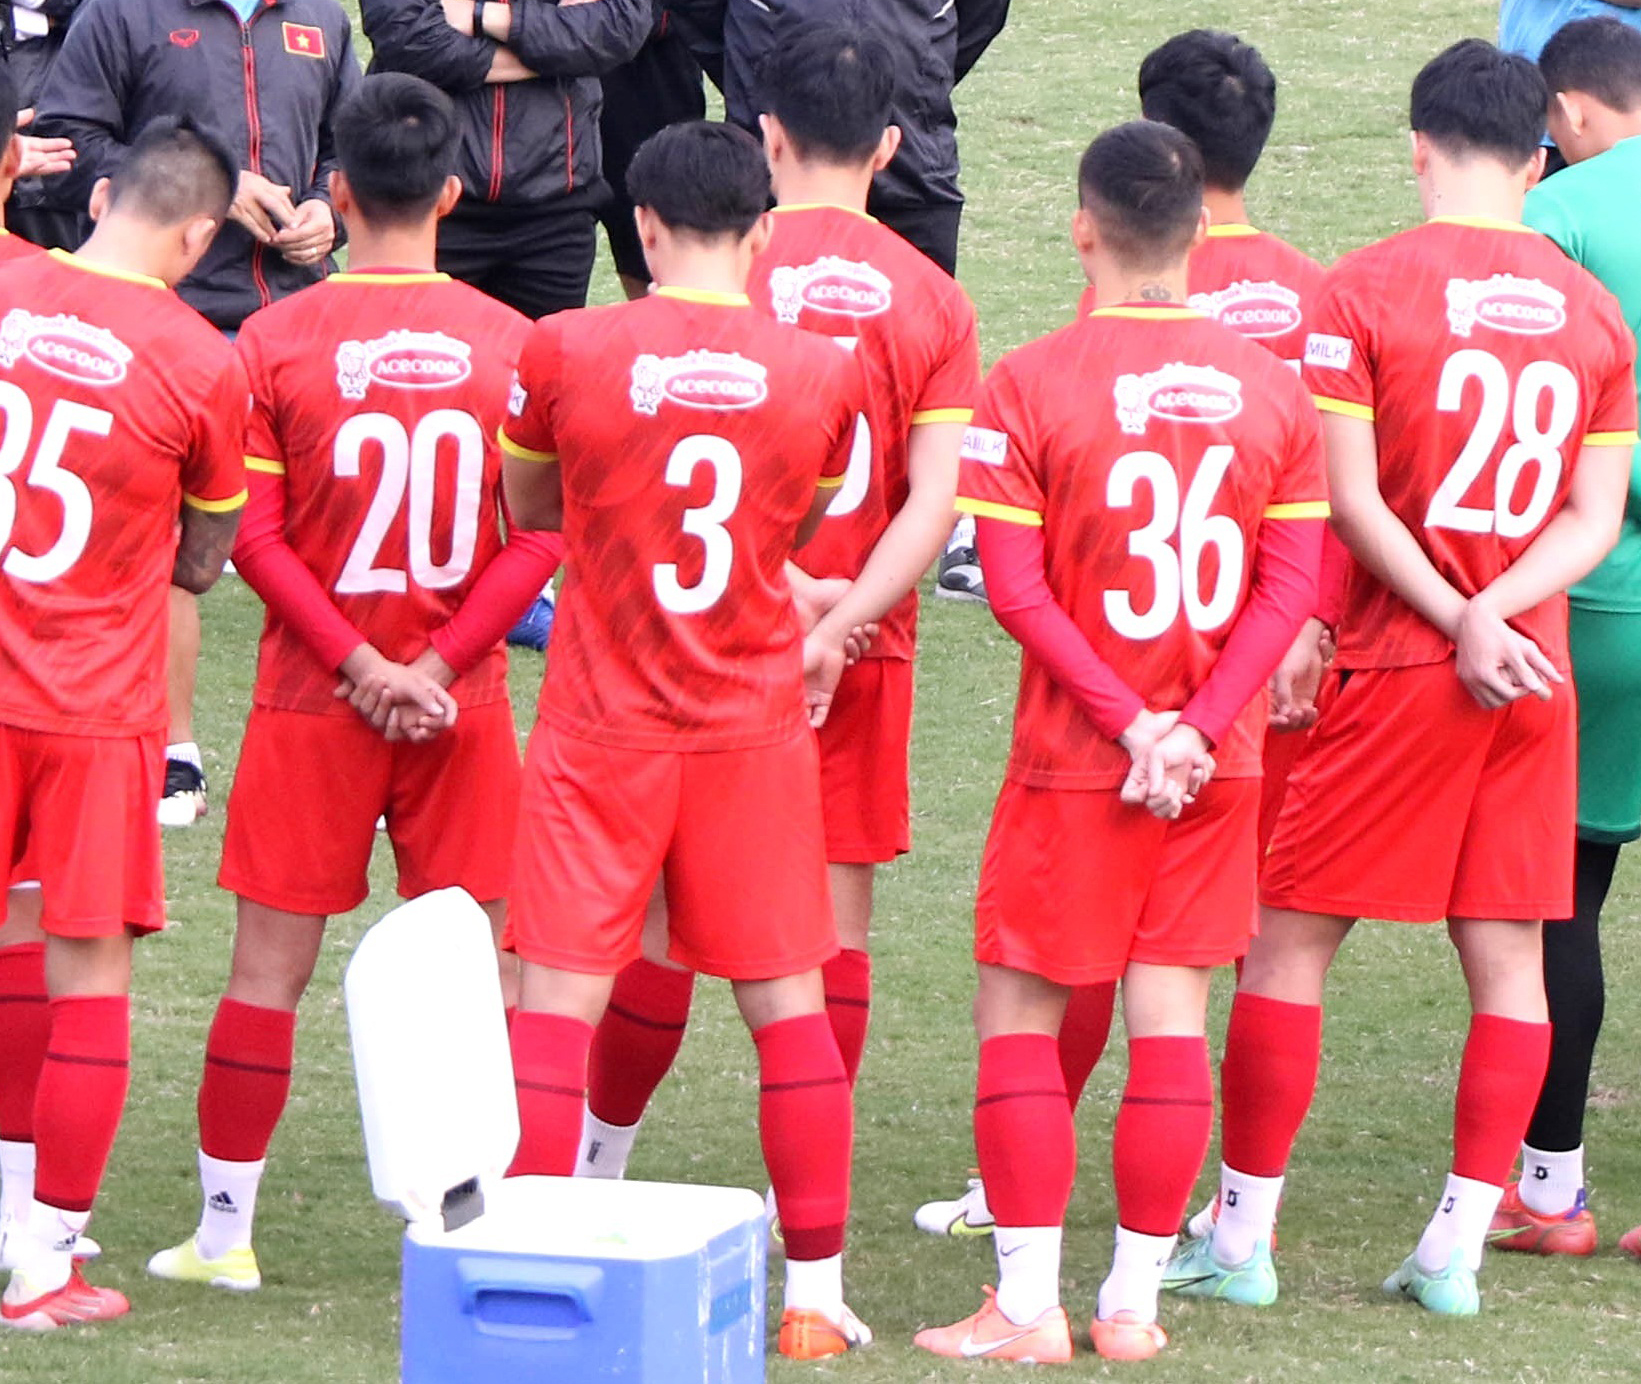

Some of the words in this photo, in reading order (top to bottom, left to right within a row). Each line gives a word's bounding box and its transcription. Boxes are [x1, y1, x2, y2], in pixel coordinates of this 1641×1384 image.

[333, 408, 485, 594] 20
[652, 433, 743, 615] 3
[1423, 348, 1579, 538] 28
[1103, 444, 1245, 641] 36
